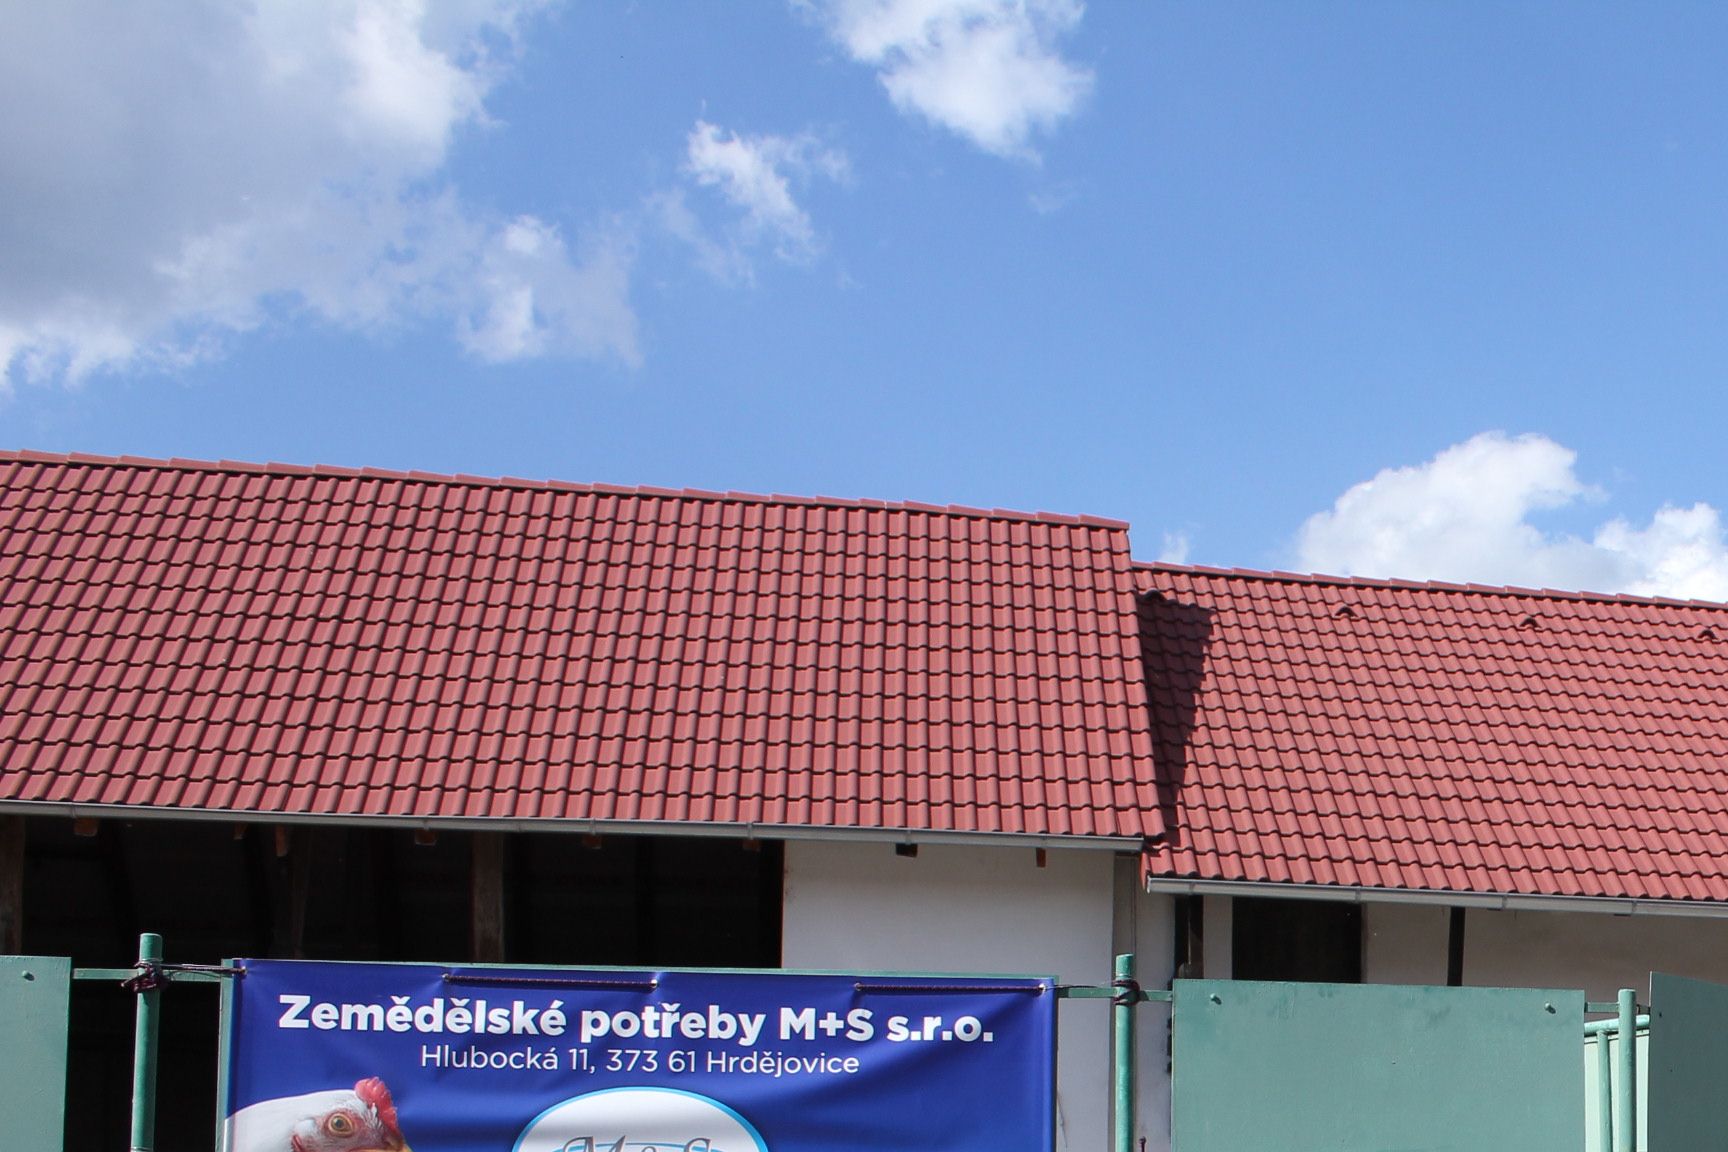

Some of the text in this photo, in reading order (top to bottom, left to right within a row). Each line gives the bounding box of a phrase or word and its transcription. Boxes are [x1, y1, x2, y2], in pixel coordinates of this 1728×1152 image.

[278, 994, 994, 1046] Zemědělské potřeby M+S s.r.o.
[421, 1045, 860, 1079] Hlubocká 11, 373 61 Hrdějovice
